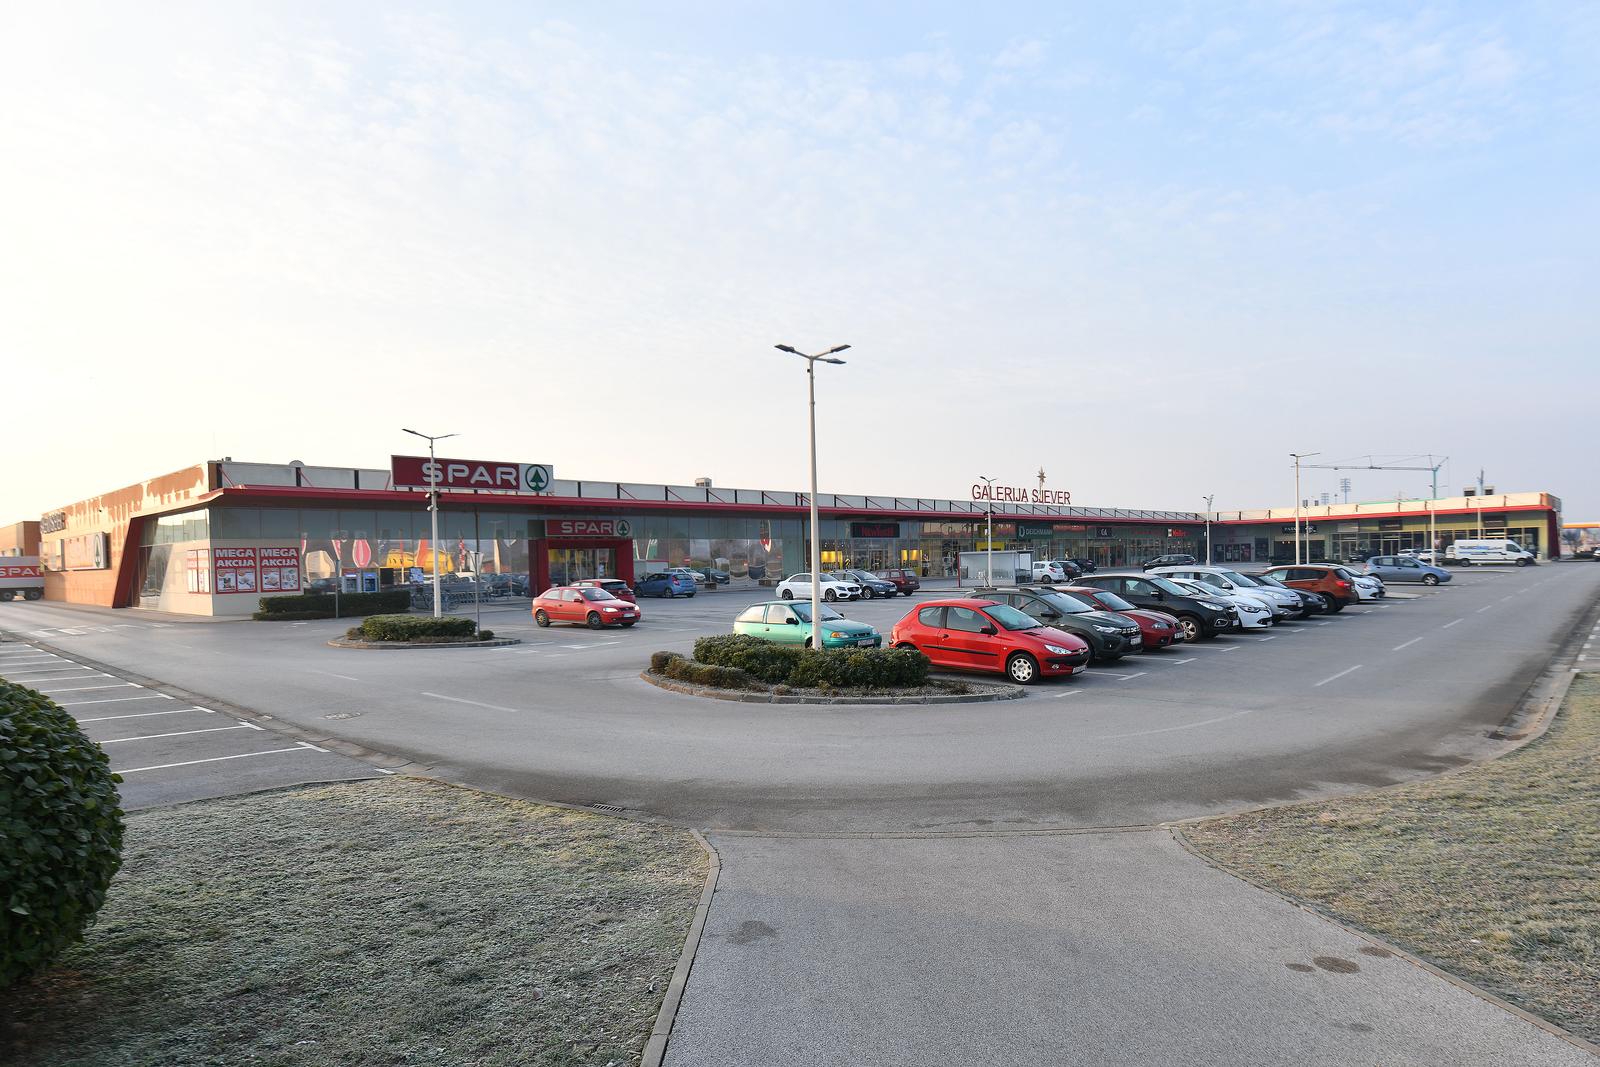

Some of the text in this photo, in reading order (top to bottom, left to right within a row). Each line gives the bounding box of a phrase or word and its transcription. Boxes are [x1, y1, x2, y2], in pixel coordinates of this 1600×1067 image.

[421, 462, 518, 486] SPAR
[971, 484, 1071, 505] GALERIJA SJEVER
[560, 521, 613, 534] SPAR
[215, 549, 255, 557] MEGA
[261, 548, 297, 557] MEGA
[216, 559, 255, 567] AKCIJA
[0, 567, 40, 577] SPA
